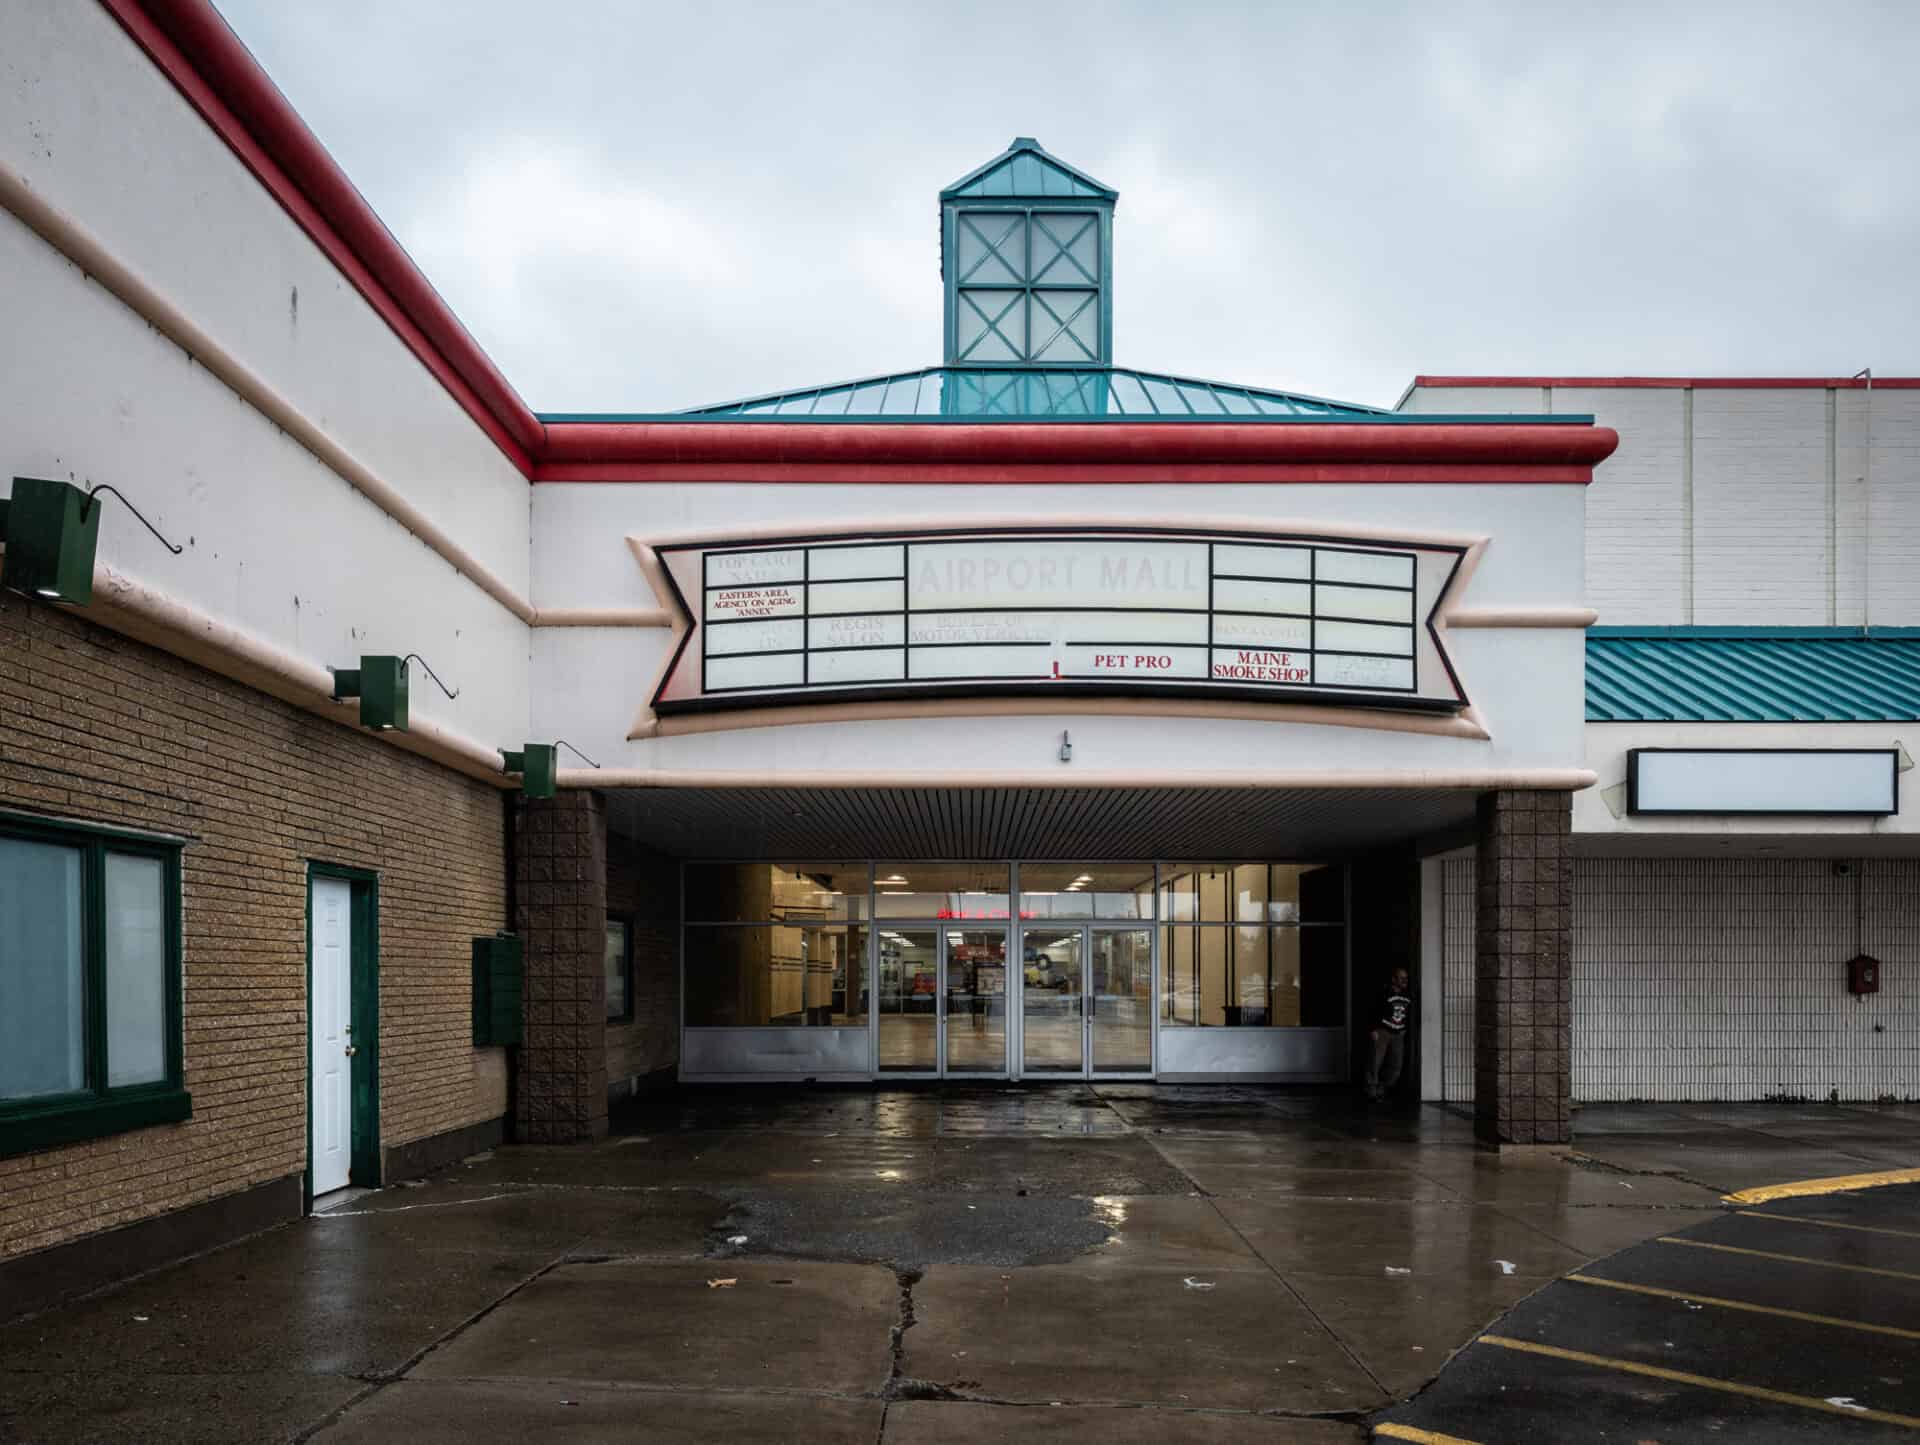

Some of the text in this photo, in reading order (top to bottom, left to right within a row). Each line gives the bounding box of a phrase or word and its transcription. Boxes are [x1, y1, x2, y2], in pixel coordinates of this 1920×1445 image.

[917, 556, 1200, 592] AIRPORT MALL
[719, 589, 789, 600] EASTERN AREA
[714, 600, 748, 608] AGENCY
[751, 599, 765, 607] ON
[1094, 655, 1172, 669] PET PRO
[1236, 651, 1291, 666] MAINE
[1213, 664, 1309, 682] SMOKE SHOP
